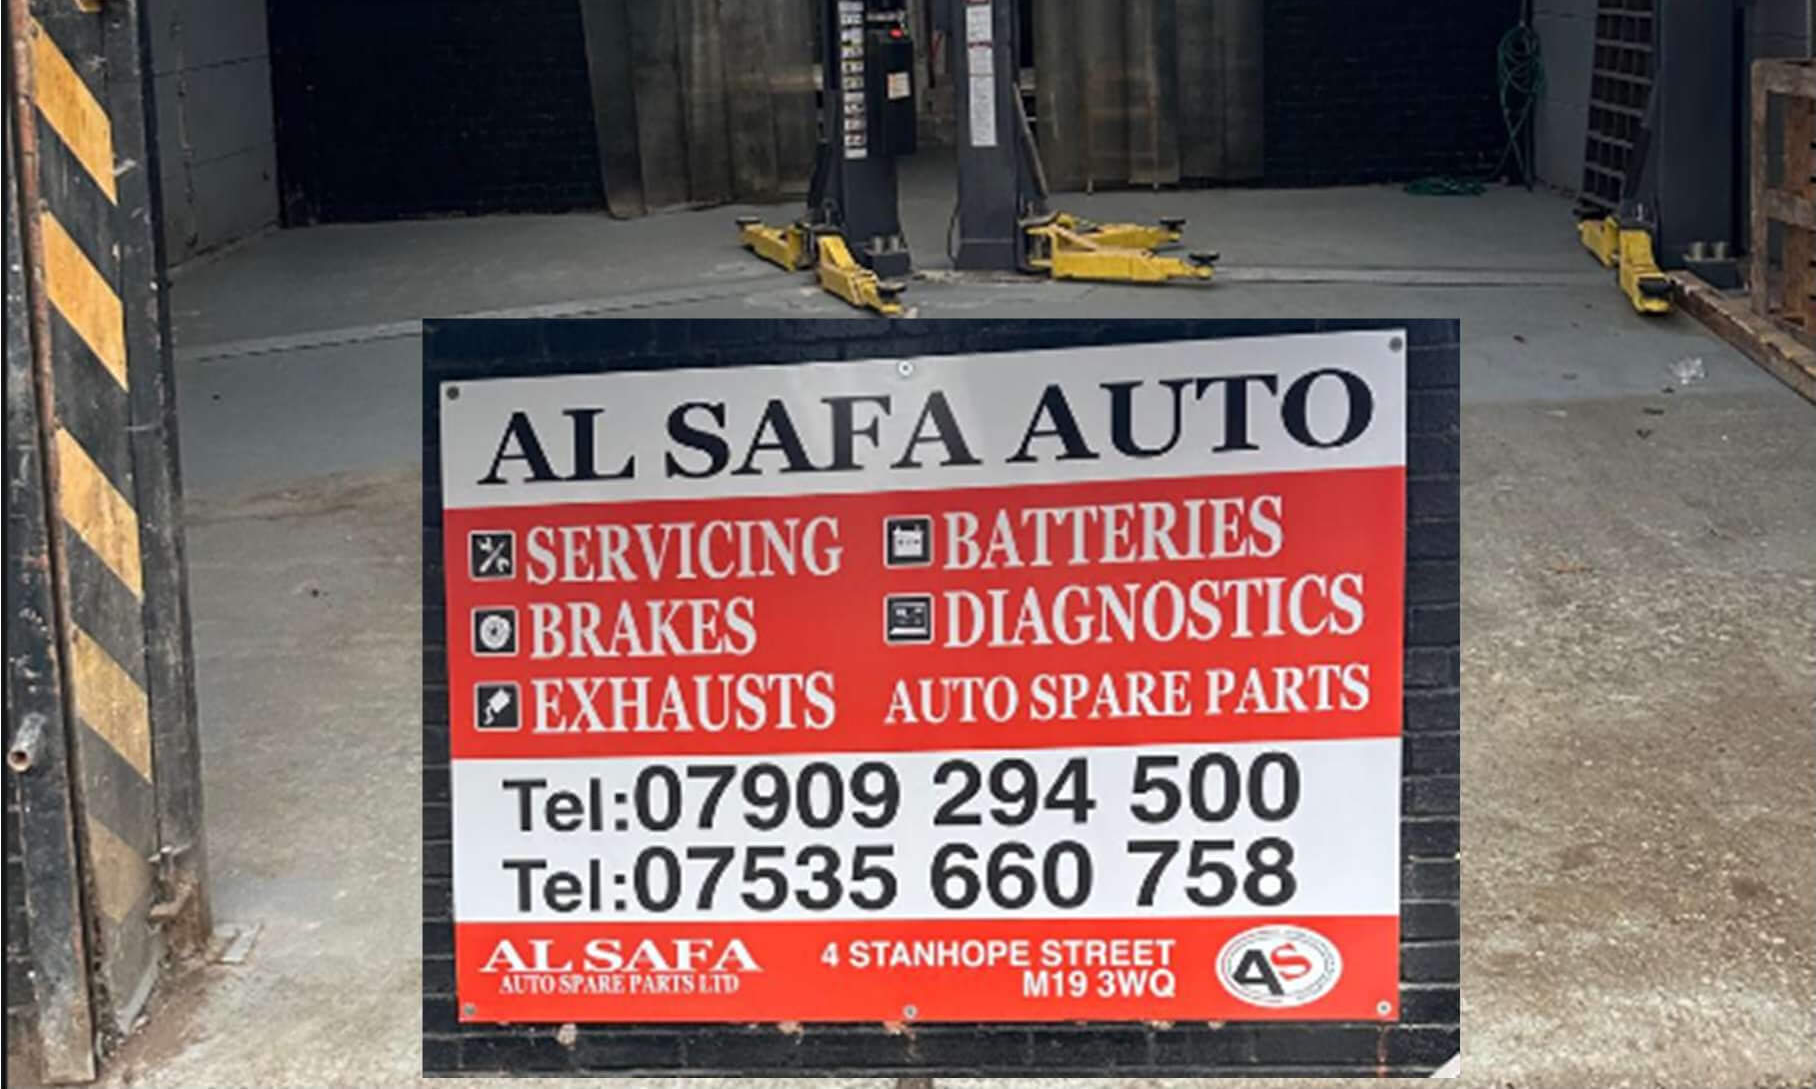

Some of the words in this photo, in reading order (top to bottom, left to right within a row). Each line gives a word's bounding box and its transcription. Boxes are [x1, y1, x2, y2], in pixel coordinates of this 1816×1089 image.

[476, 408, 635, 486] AL
[665, 390, 982, 479] SAFA
[1005, 367, 1374, 463] AUTO
[525, 515, 844, 584] SERVICING
[942, 495, 1284, 571] BATTERIES
[530, 596, 757, 659] BRAKES
[943, 573, 1365, 648] DIAGNOSTICS
[531, 671, 837, 734] EXHAUSTS
[884, 675, 1018, 725] AUTO
[1029, 670, 1191, 721] SPARE
[1205, 662, 1371, 716] PARTS
[502, 761, 901, 832] Tel:07909
[932, 756, 1097, 826] 294
[1129, 751, 1302, 825] 500
[502, 844, 898, 912] Tel:07535
[930, 839, 1093, 910] 660
[1127, 836, 1298, 908] 758
[478, 939, 572, 973] AL
[583, 938, 763, 972] SAFA
[499, 974, 556, 994] AUTO
[558, 974, 626, 994] SPARE
[628, 974, 696, 994] PARTS
[699, 973, 740, 994] LTD
[821, 943, 838, 967] 4
[849, 941, 1030, 968] STANHOPE
[1039, 939, 1176, 966] STREET
[1022, 970, 1088, 997] M19
[1096, 969, 1176, 998] 3WQ
